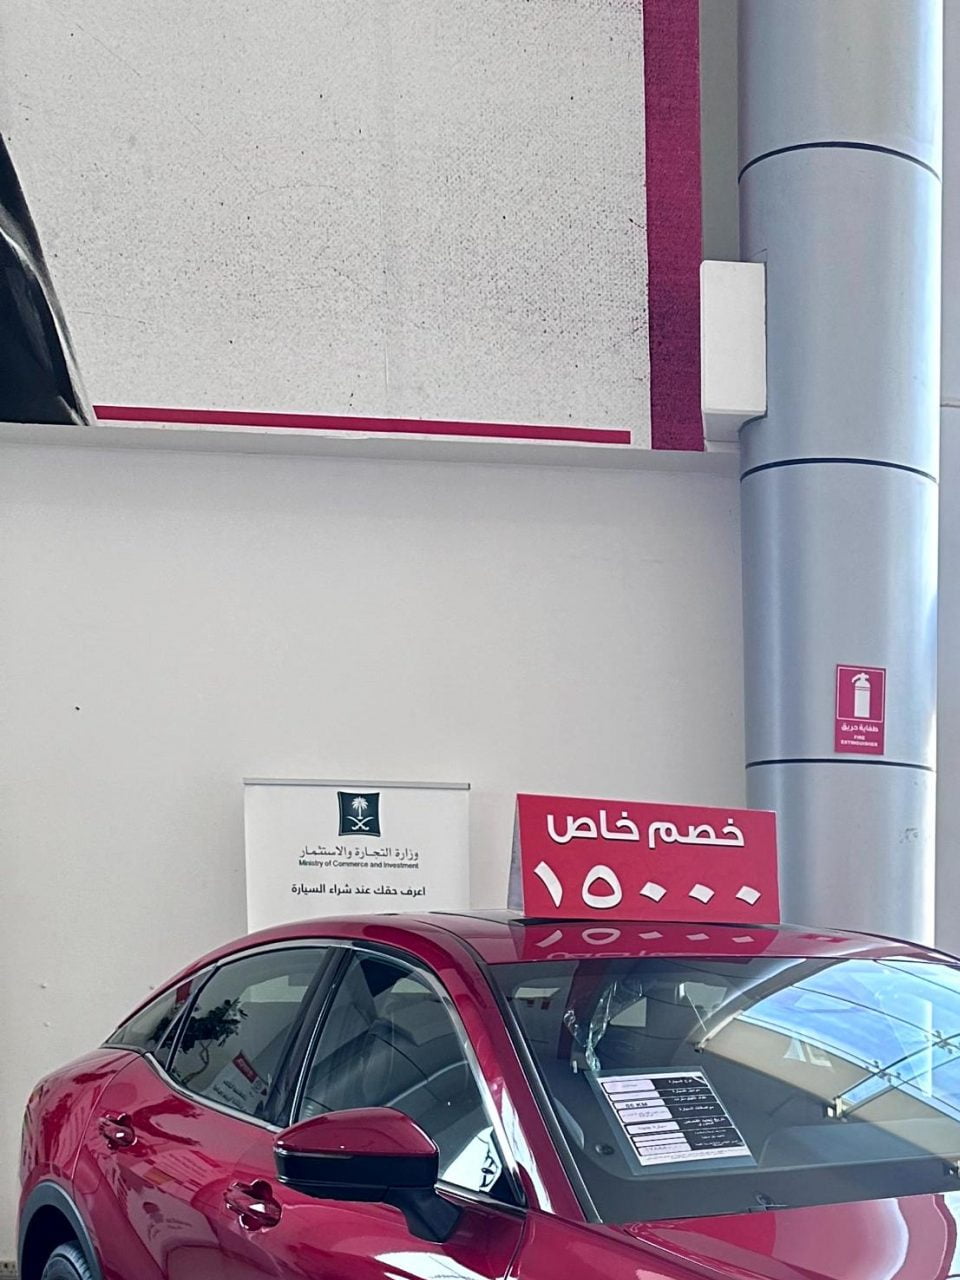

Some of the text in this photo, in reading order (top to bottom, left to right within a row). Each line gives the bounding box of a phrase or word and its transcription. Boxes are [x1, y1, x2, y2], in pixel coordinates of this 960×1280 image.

[547, 810, 745, 849] خصم خاص
[299, 845, 419, 861] وزارة التجارة والاستثمار
[298, 859, 323, 868] Ministry
[332, 860, 369, 868] Commerce
[370, 861, 383, 869] and
[291, 883, 426, 898] اعرف حقك عند شراء السيارة
[533, 860, 762, 909] ١٥٠٠٠
